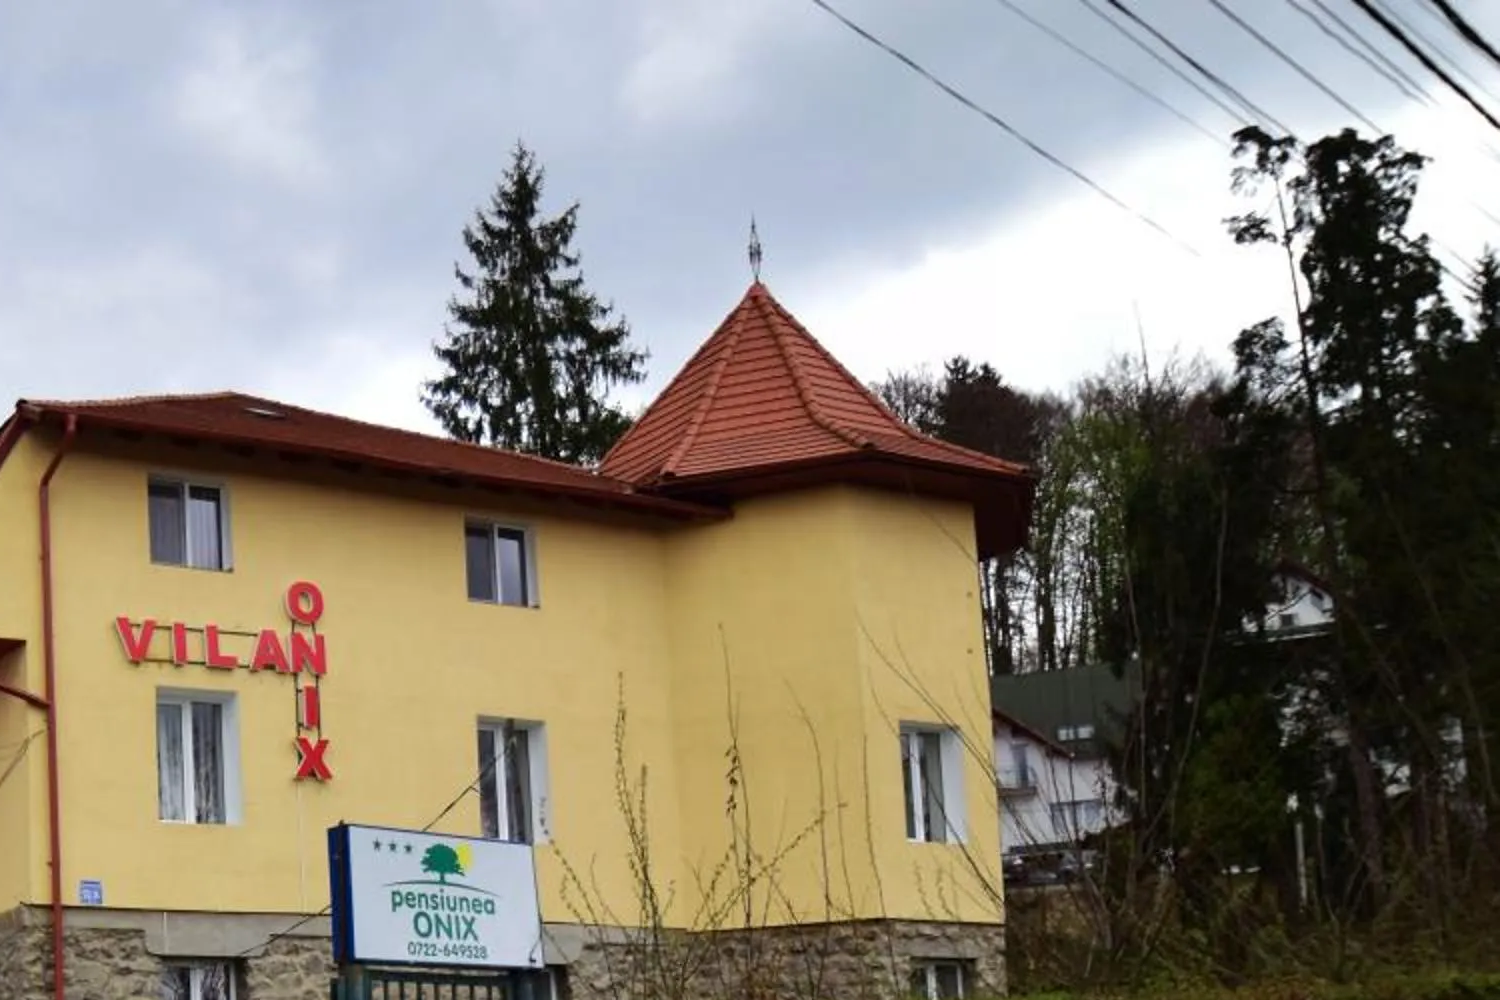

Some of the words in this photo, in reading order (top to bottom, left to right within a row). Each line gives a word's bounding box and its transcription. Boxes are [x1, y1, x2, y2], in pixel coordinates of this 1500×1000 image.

[115, 616, 290, 673] VILA
[287, 580, 333, 781] ONIX
[391, 888, 495, 915] pensiunea
[413, 911, 479, 942] ONIX
